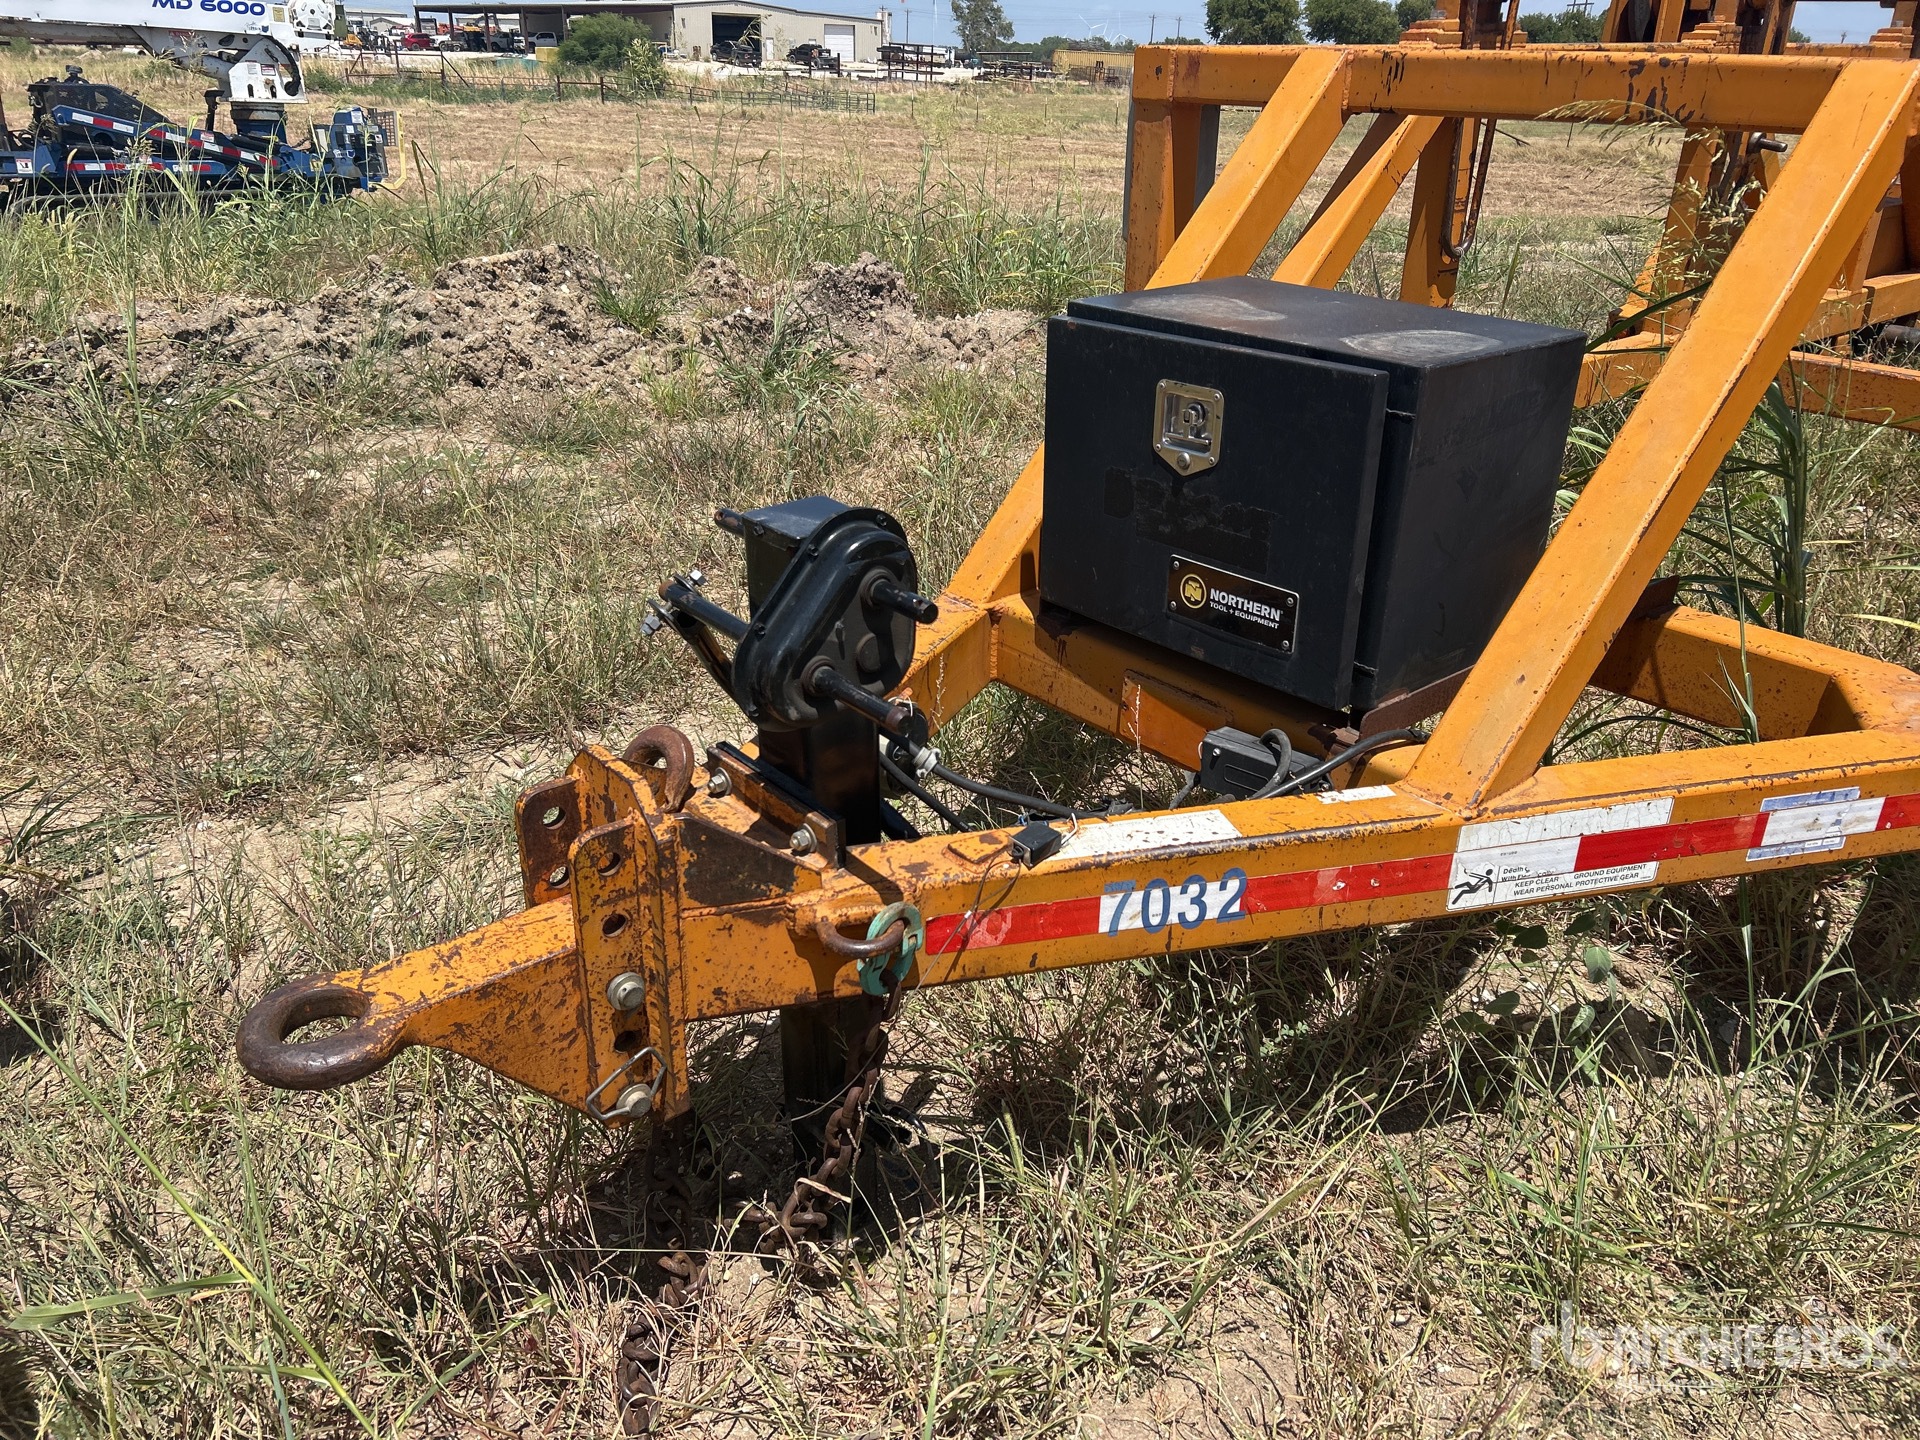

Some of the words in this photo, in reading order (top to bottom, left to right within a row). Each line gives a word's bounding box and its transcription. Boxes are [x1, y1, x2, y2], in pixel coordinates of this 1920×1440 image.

[152, 0, 193, 10] MD
[200, 0, 265, 16] 6000
[1210, 588, 1281, 622] NORTHERN
[1210, 601, 1228, 613] TOOL
[1235, 610, 1280, 630] EQUIPMENT
[1514, 886, 1535, 896] WEAR
[1535, 882, 1573, 894] PERSONAL
[1574, 875, 1620, 887] PROTECTIVE
[1620, 872, 1640, 881] GEAR
[1515, 877, 1535, 888] KEEP
[1535, 876, 1560, 886] CLEAR
[1574, 870, 1605, 880] GROUND
[1606, 863, 1648, 875] EQUIPMENT
[1104, 867, 1248, 937] 7032
